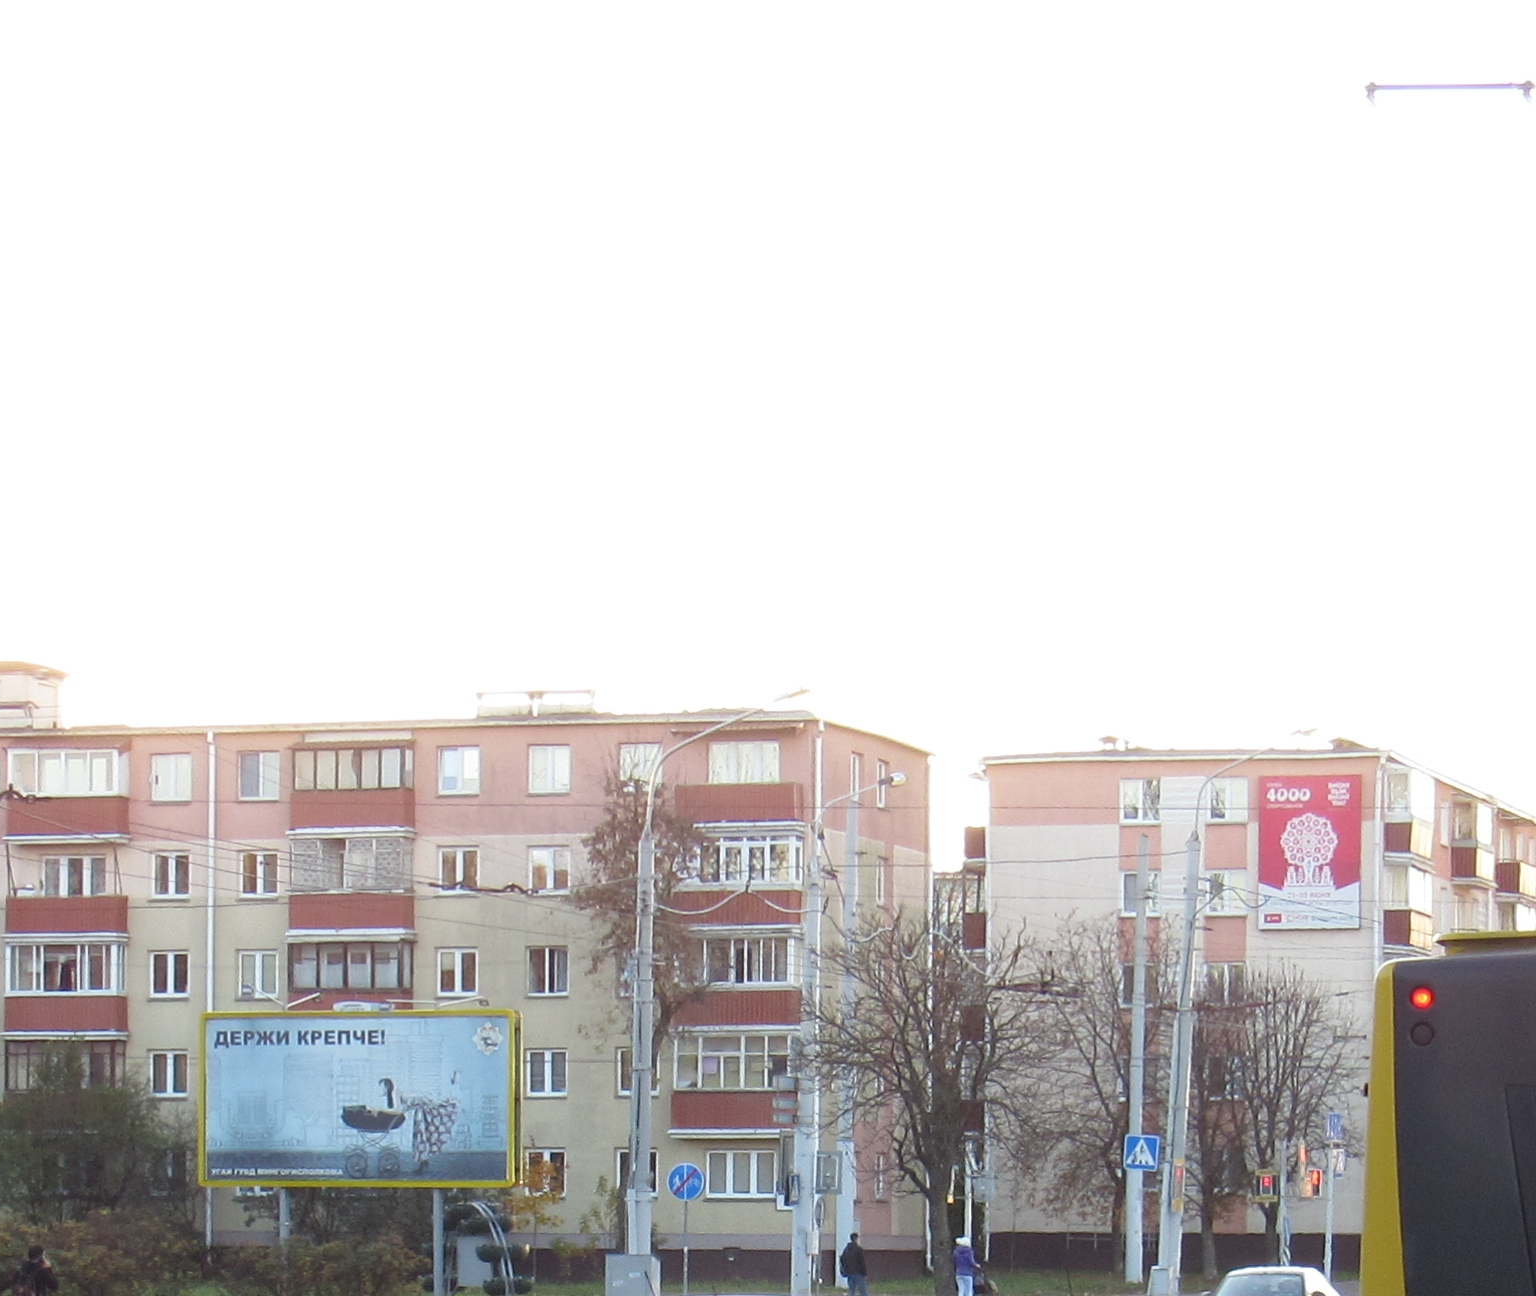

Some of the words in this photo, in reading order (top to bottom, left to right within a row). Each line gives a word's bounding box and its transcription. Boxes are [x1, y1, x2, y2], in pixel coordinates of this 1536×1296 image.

[1266, 787, 1311, 802] 4000
[214, 1030, 290, 1048] ДЕРЖИ
[298, 1030, 386, 1046] КРЕПЧЕ!
